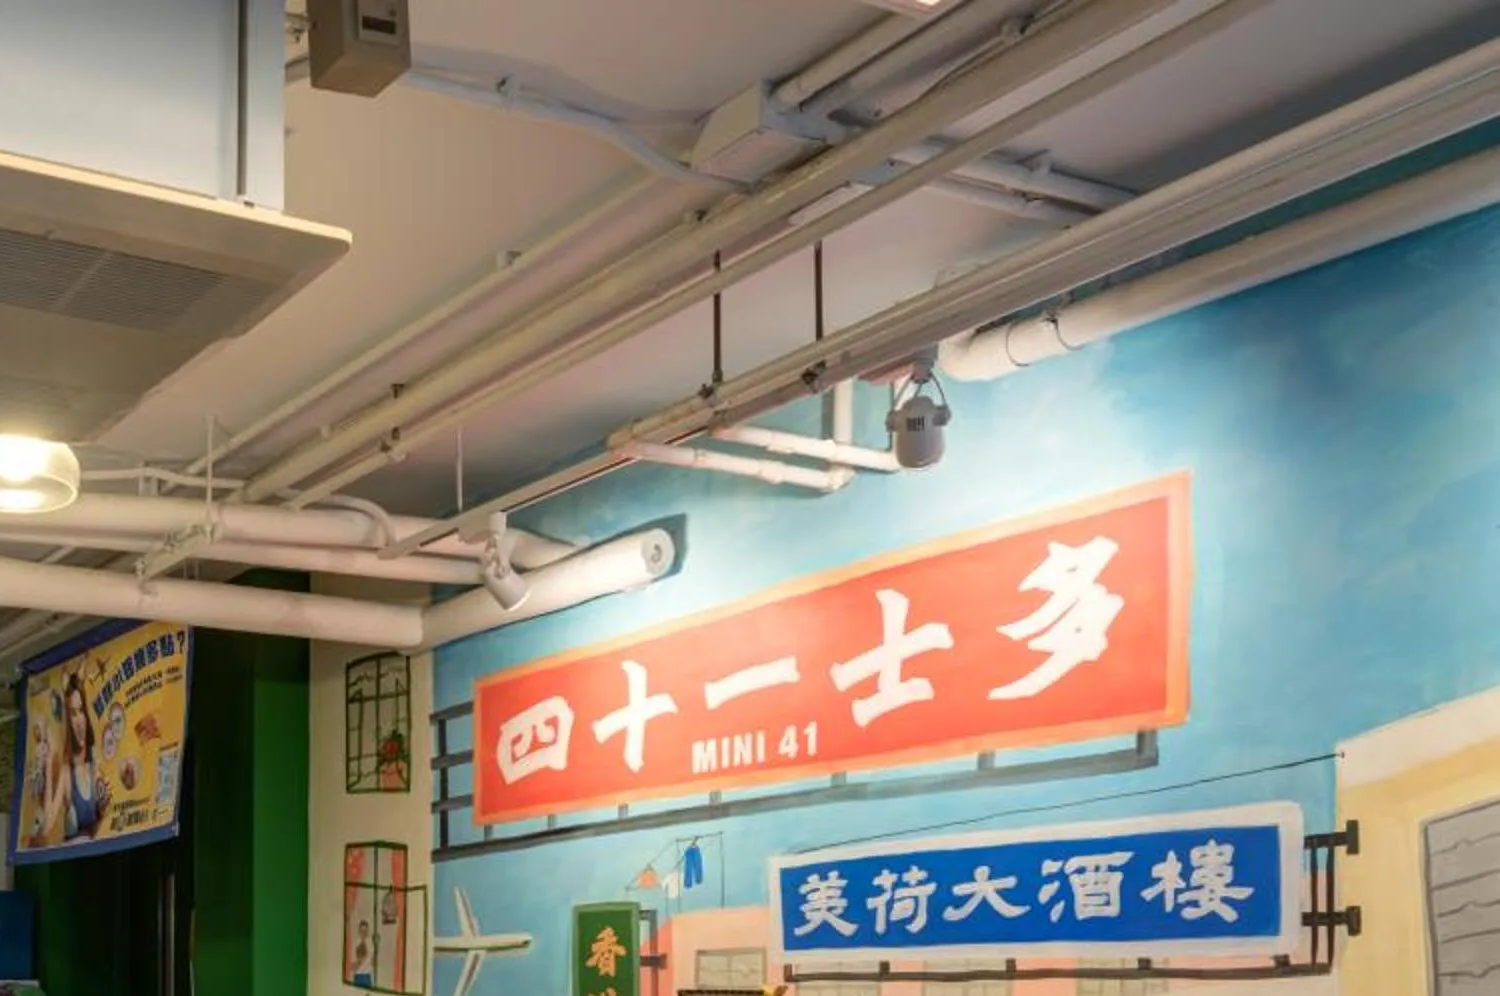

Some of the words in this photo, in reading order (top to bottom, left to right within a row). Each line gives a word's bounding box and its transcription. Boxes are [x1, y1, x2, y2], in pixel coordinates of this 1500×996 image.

[495, 534, 1126, 786] 四十一士多
[691, 729, 767, 775] MINI
[778, 722, 819, 760] 41
[792, 838, 1257, 938] 美荷大酒樓
